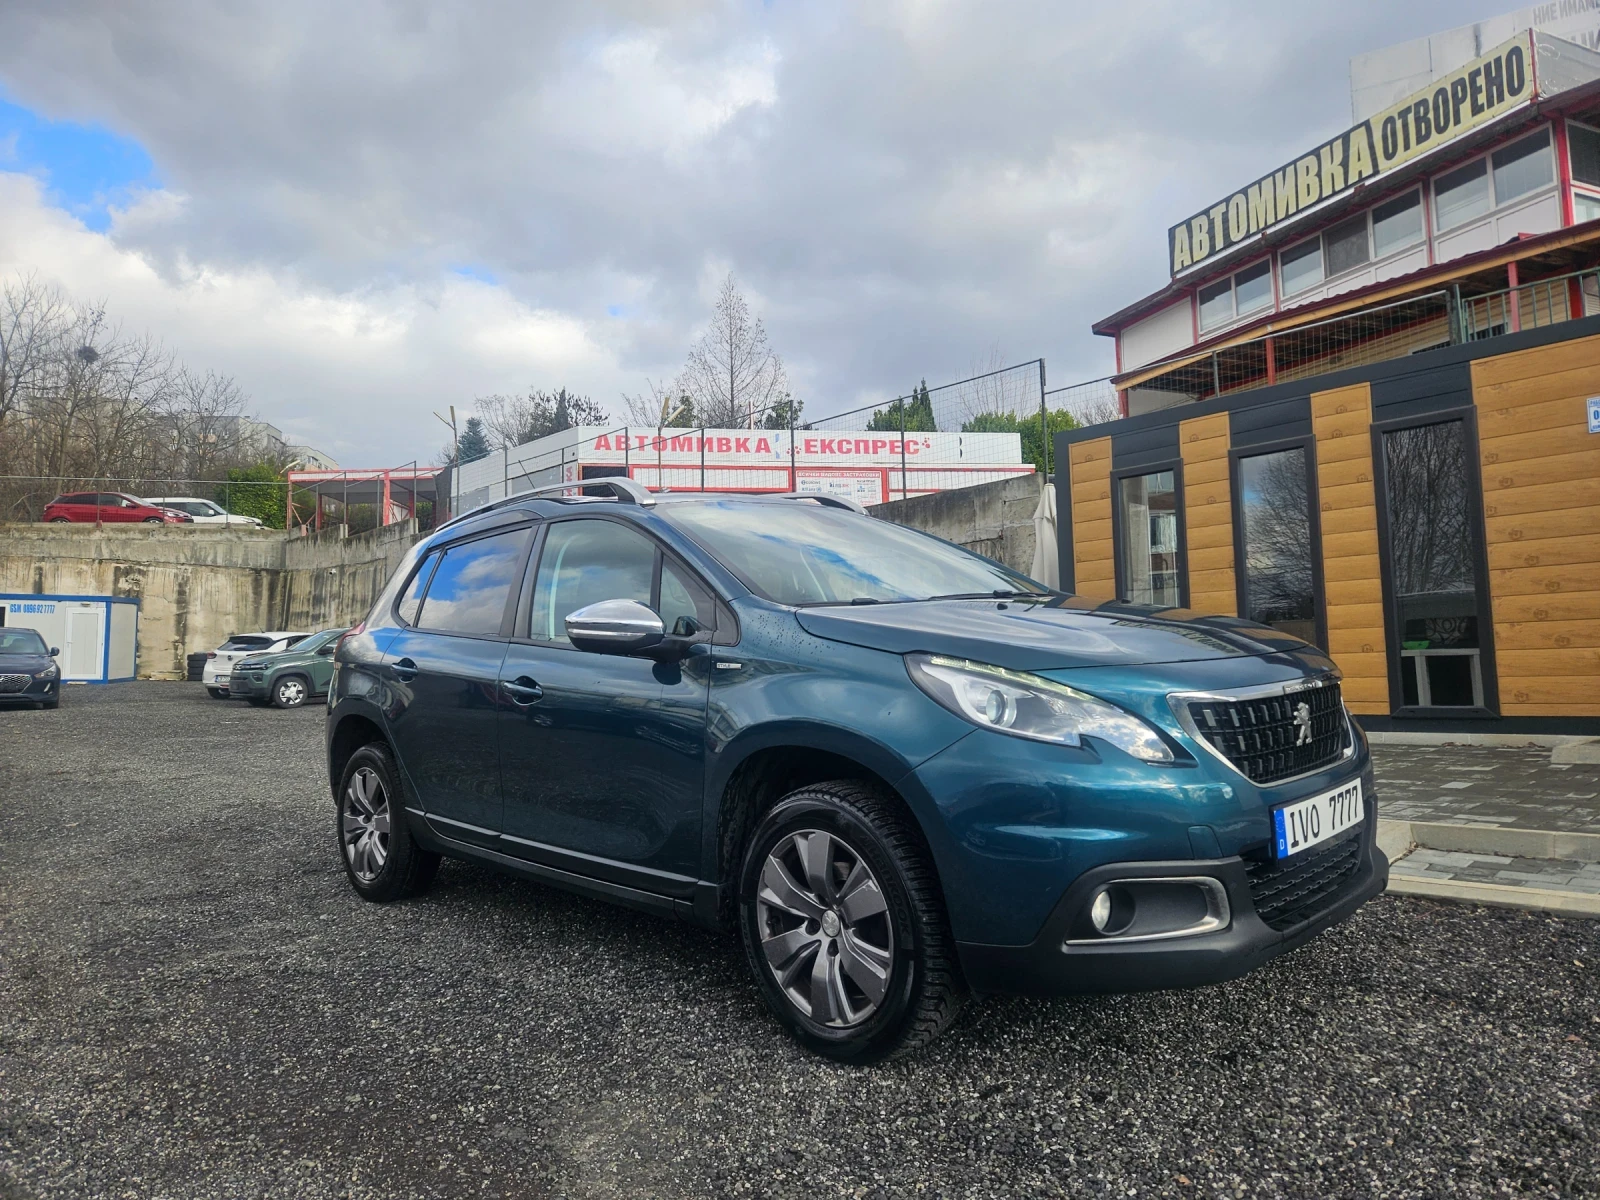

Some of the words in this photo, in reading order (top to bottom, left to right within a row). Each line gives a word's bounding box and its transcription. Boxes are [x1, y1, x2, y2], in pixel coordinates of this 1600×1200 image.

[1173, 125, 1374, 272] АВТОМИВКА
[1381, 45, 1525, 161] ОТВОРЕНО
[594, 434, 772, 454] АВТОМИВКА
[804, 438, 920, 455] ЕКСПРЕС
[10, 603, 21, 613] GSM
[1290, 804, 1320, 848] IVO
[1329, 785, 1358, 830] 7777
